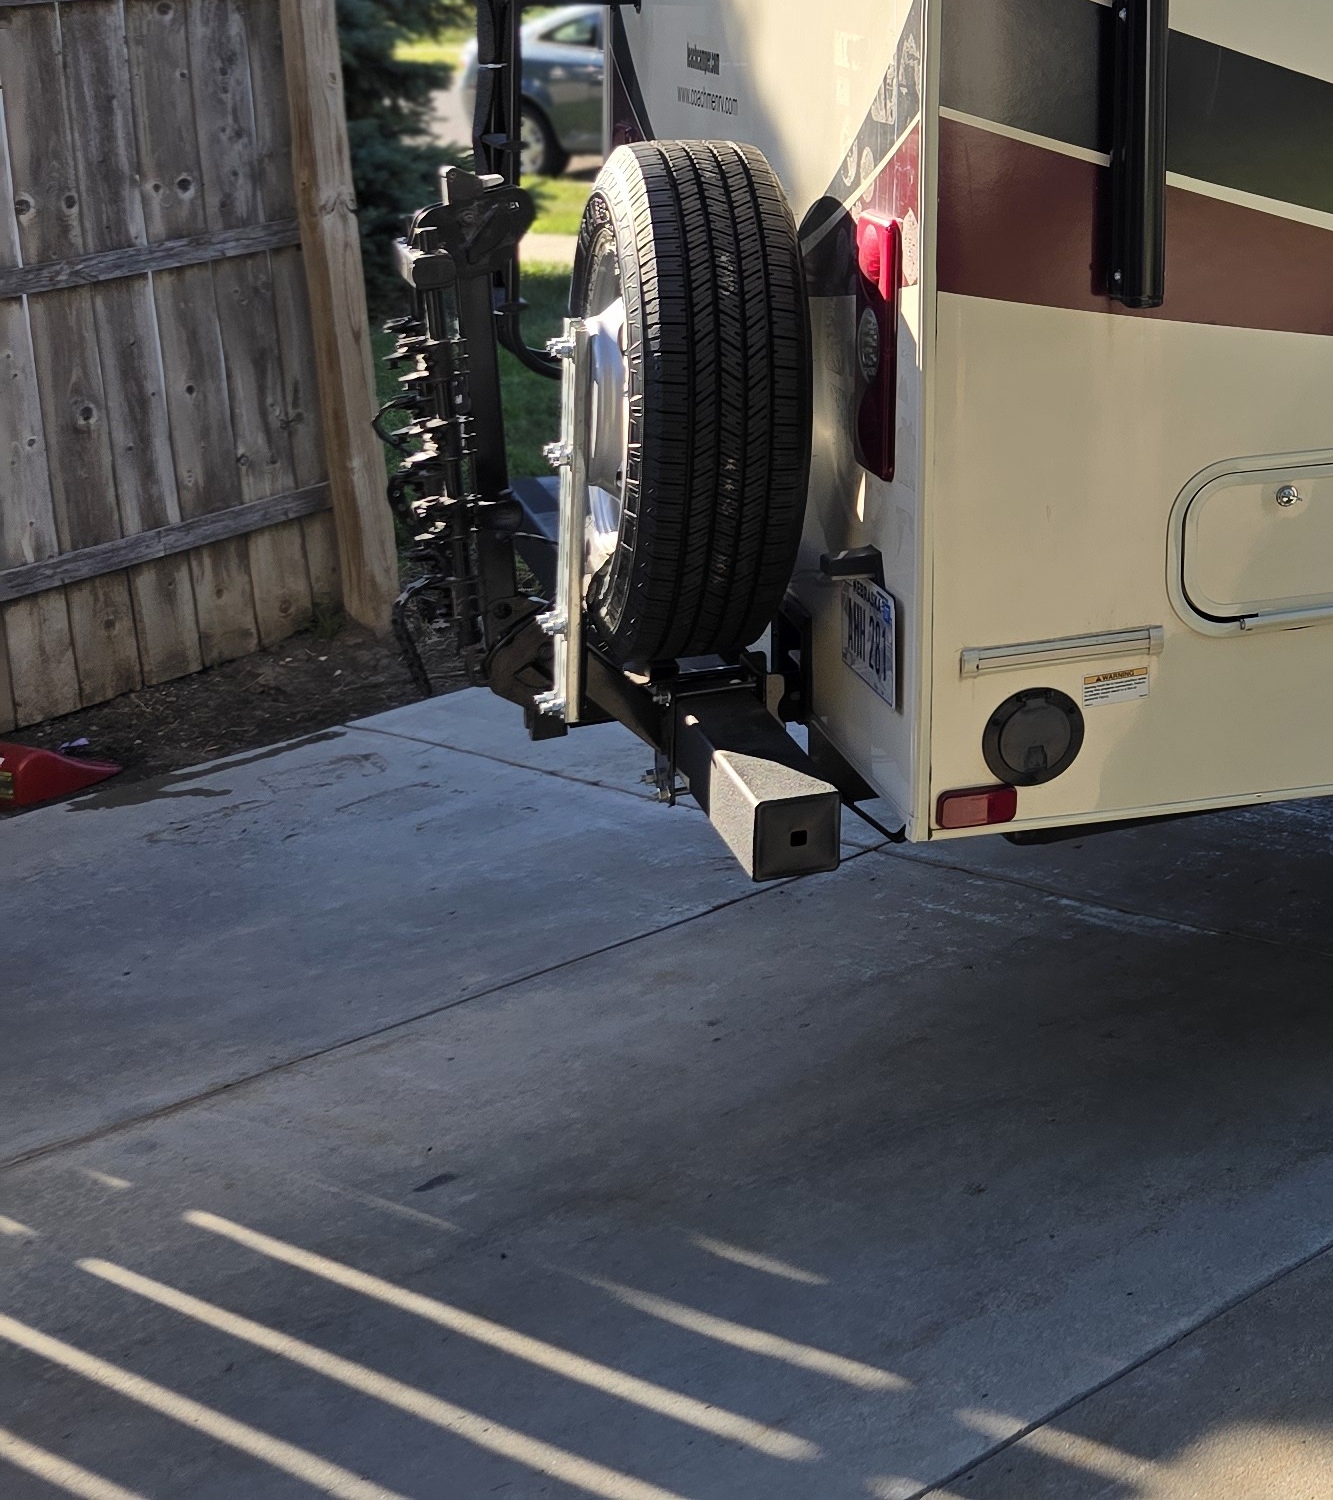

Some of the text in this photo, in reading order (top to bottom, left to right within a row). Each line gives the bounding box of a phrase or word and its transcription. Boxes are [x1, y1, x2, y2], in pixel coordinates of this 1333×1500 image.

[677, 85, 739, 116] www.coachmenrv.com
[868, 615, 886, 682] 281
[1102, 670, 1135, 681] WARNING
